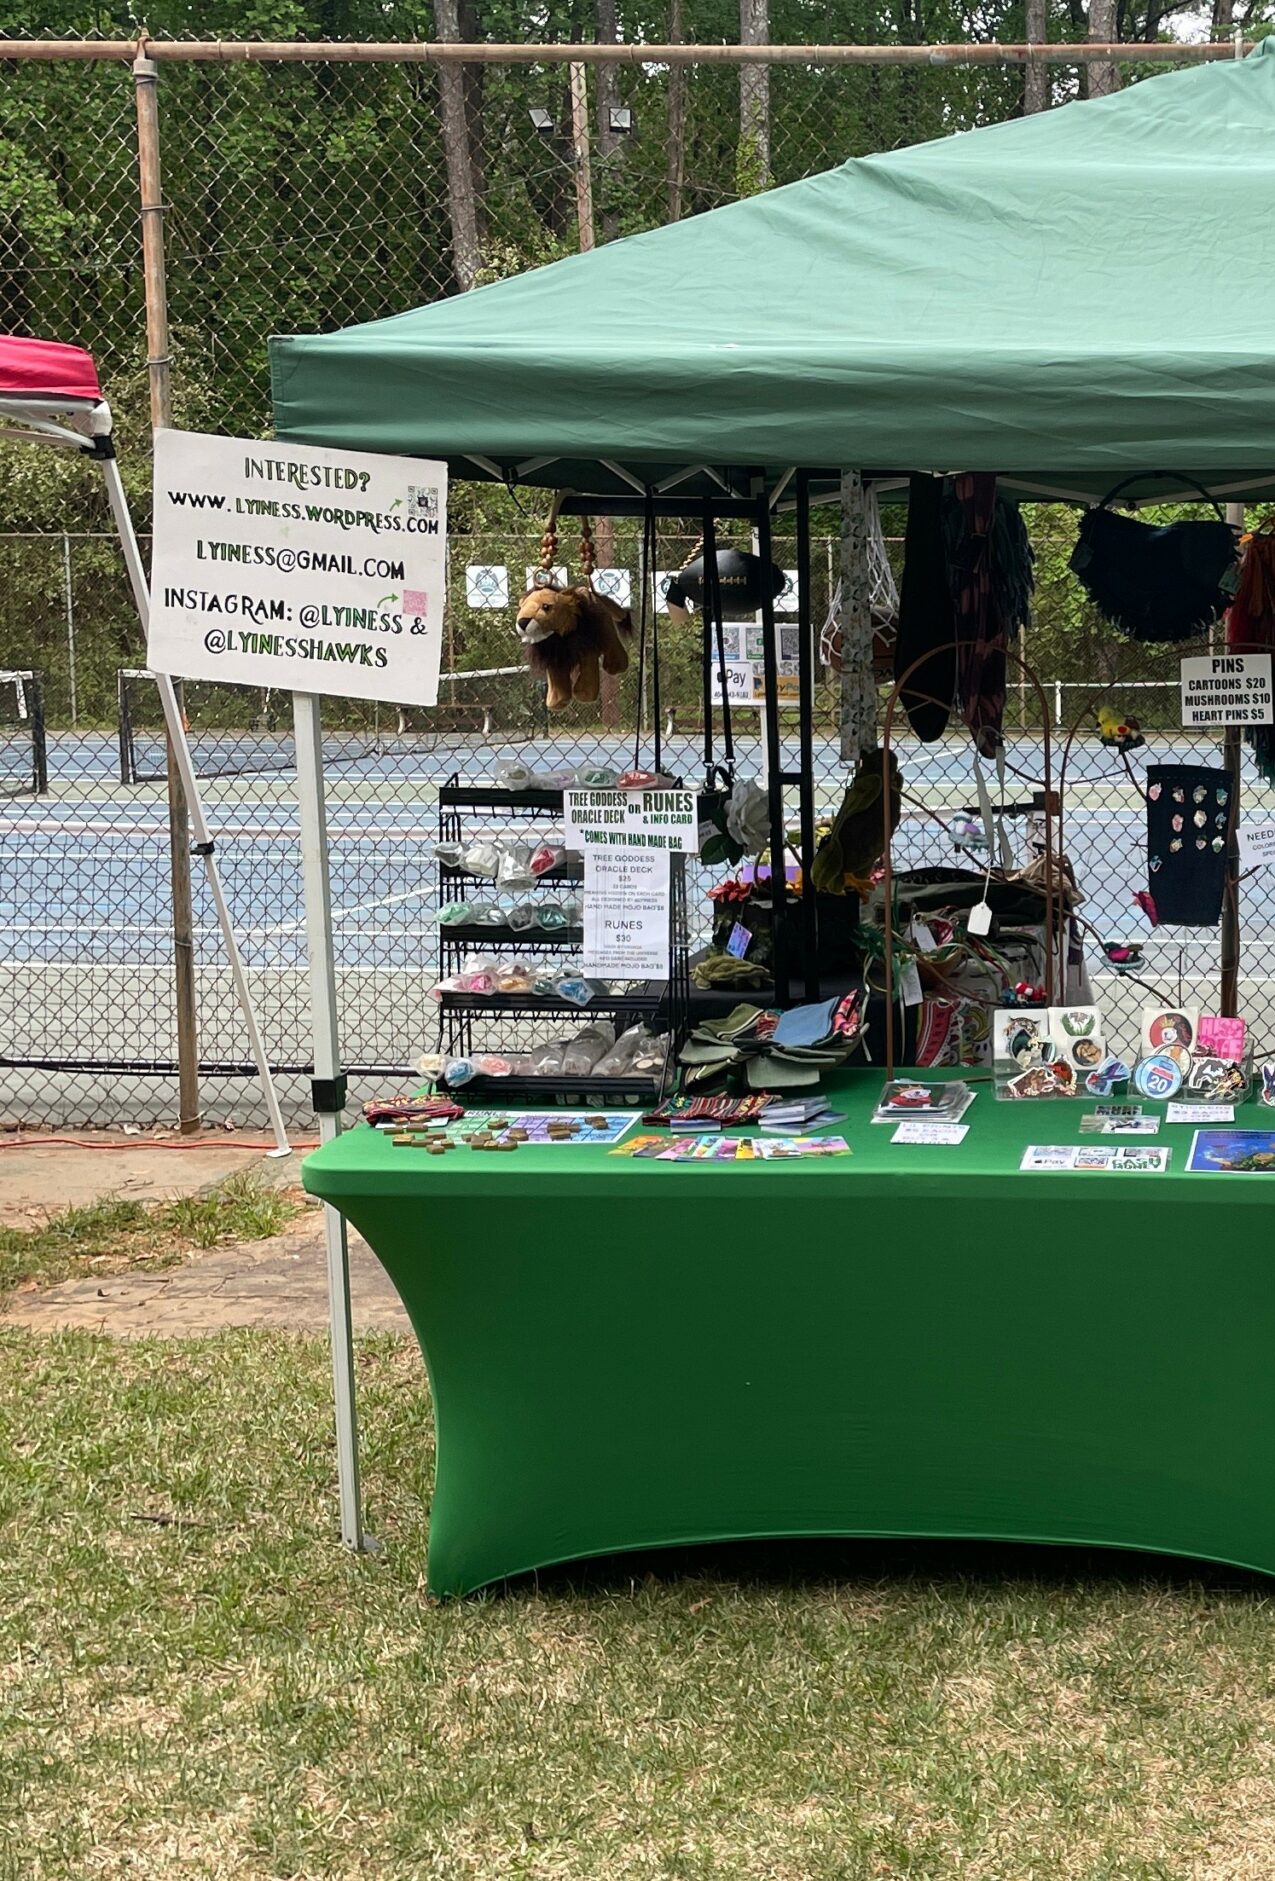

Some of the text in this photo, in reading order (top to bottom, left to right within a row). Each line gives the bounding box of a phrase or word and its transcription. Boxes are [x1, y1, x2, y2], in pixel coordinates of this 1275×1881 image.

[244, 457, 371, 491] INTERESTED?
[197, 540, 405, 580] LYINESS@GMAIL.COM
[164, 588, 428, 636] INSTAGRAM: @LYINESS &
[204, 629, 388, 668] @LYINESSHAWKS
[1212, 658, 1245, 674] PINS
[726, 669, 746, 687] Pay
[1188, 677, 1266, 691] CARTOONS $20
[1185, 692, 1271, 707] MUSHROOMS $10
[1192, 707, 1265, 722] HEART PINS $5
[568, 791, 628, 807] TREE GODDESS
[643, 792, 694, 813] RUNES
[571, 809, 625, 824] ORACLE DECK
[628, 803, 641, 815] OR
[643, 814, 693, 825] & INFO CARD
[609, 832, 627, 846] WITH
[627, 833, 647, 848] HAND
[647, 834, 667, 849] MADE
[668, 836, 683, 850] BAG
[595, 865, 628, 873] ORACLE
[605, 920, 643, 930] RUNES
[616, 934, 631, 942] $30
[1148, 1075, 1167, 1092] 20
